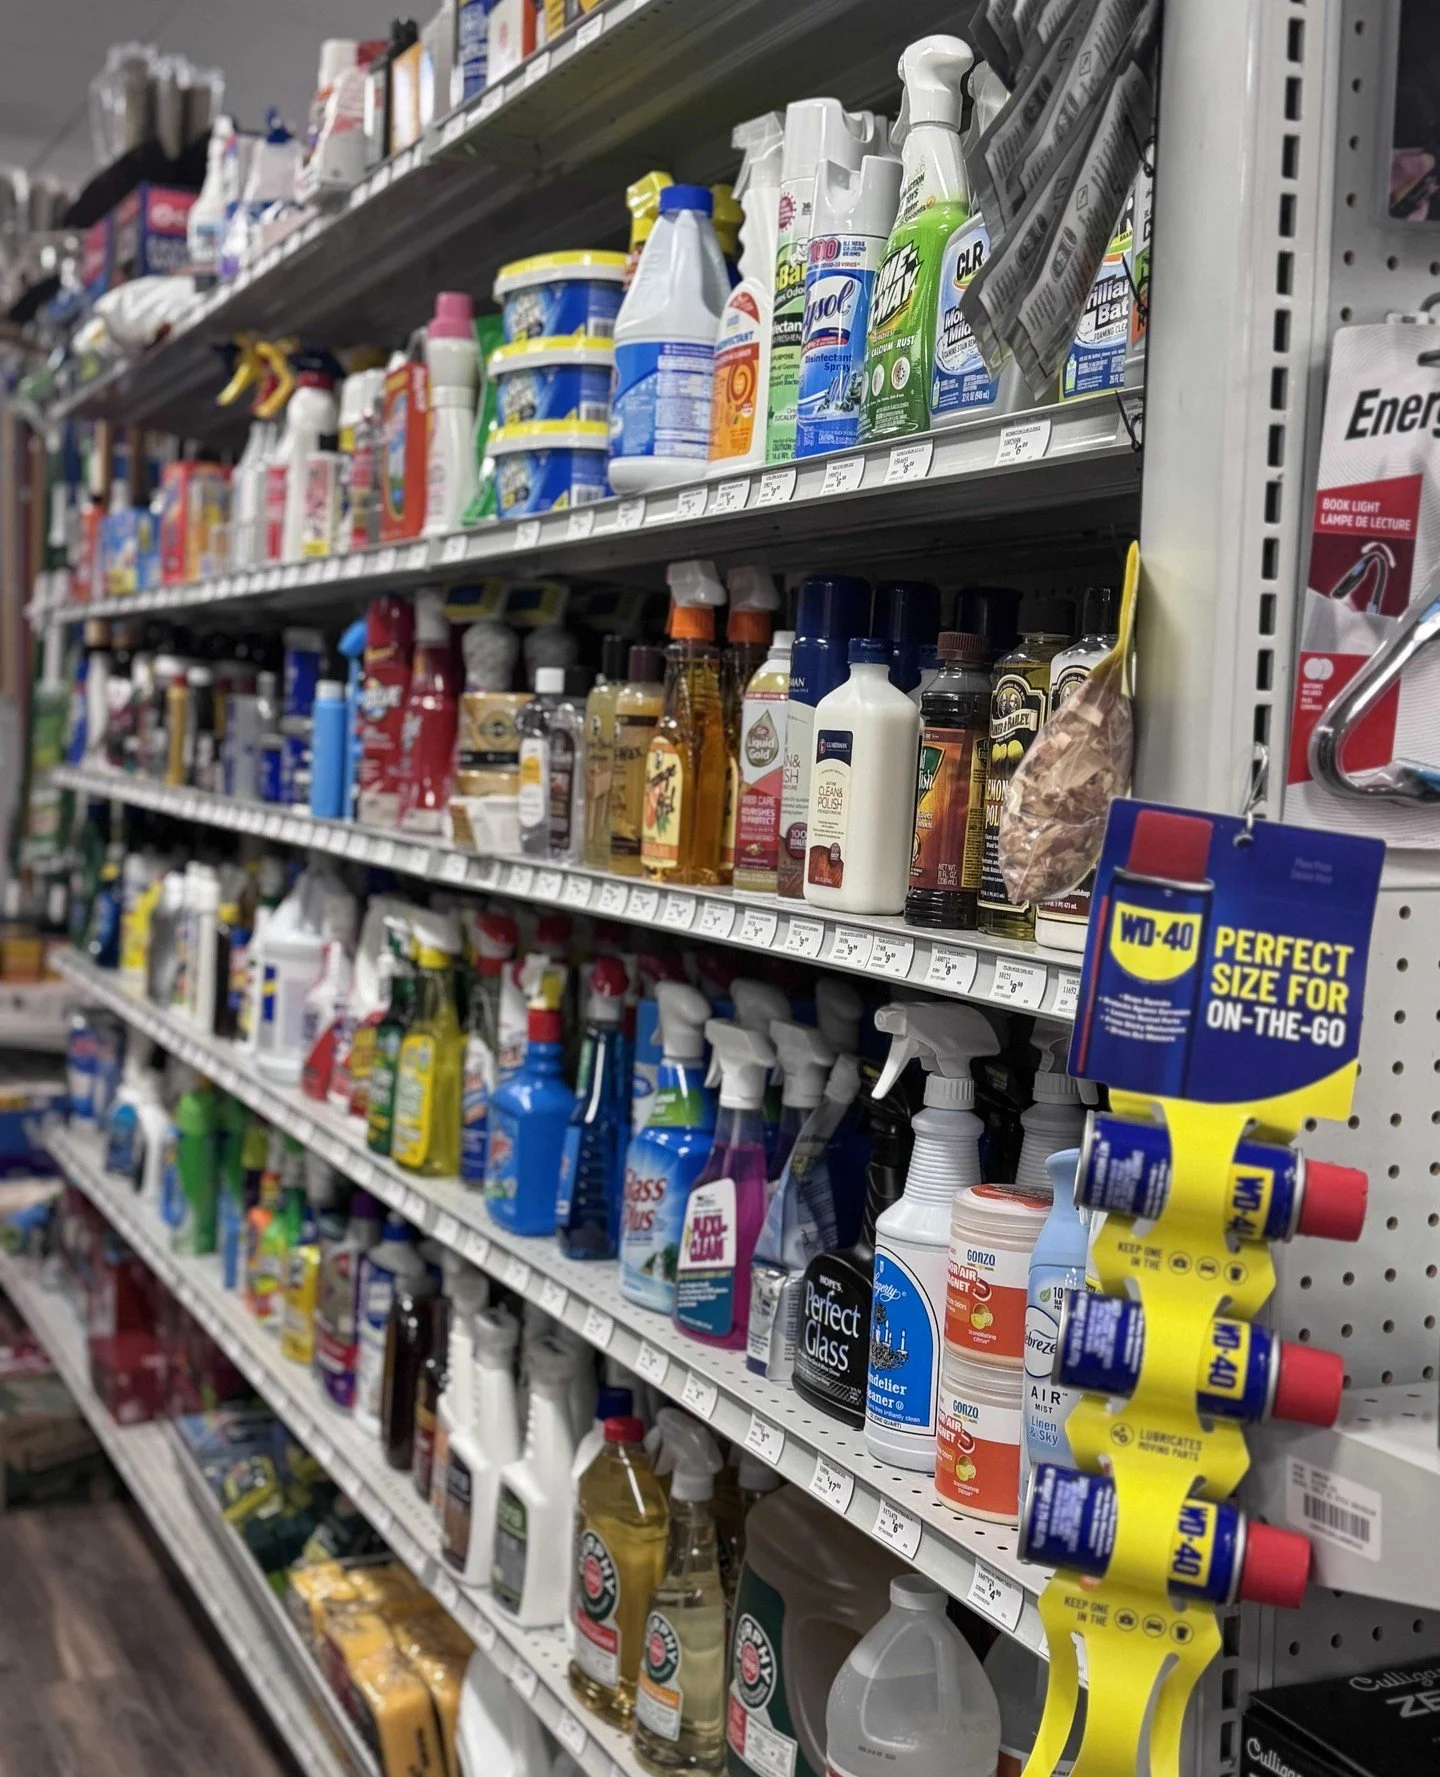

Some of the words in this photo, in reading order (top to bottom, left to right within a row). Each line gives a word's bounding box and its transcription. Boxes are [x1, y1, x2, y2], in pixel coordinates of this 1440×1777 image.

[957, 240, 984, 281] CLR
[1097, 299, 1129, 324] Bat
[872, 342, 893, 357] CALCIUM
[896, 336, 915, 348] RUST
[805, 354, 852, 364] Disinfectant
[824, 363, 851, 372] Spray
[1323, 498, 1350, 510] BOOK
[1352, 501, 1381, 513] LIGHT
[1321, 514, 1353, 527] LAMPE
[1356, 516, 1368, 528] DE
[1370, 518, 1411, 531] LECTURE
[747, 737, 775, 750] Liquid
[748, 749, 770, 760] Gold
[758, 795, 776, 806] CARE
[817, 797, 842, 810] POLISH
[790, 838, 807, 847] QUALI
[791, 830, 807, 839] 100
[938, 863, 948, 871] NET
[1121, 912, 1194, 951] WD-40
[1214, 925, 1354, 978] PERFECT
[1210, 962, 1281, 1005] SIZE
[1286, 974, 1349, 1014] FOR
[1206, 999, 1346, 1048] ON-THE-GO
[1118, 1241, 1142, 1255] KEEP
[1144, 1244, 1163, 1259] ONE
[1131, 1256, 1141, 1267] IN
[1144, 1258, 1161, 1271] THE
[960, 1266, 977, 1281] AIR
[819, 1275, 843, 1292] HOPE'S
[805, 1280, 861, 1339] Perfect
[805, 1319, 849, 1372] Glass
[1035, 1403, 1053, 1414] MIST
[905, 1413, 921, 1423] clean
[946, 1417, 963, 1433] AIR
[1031, 1416, 1057, 1432] Linen
[1030, 1428, 1036, 1439] &
[1039, 1430, 1059, 1447] Sky
[1139, 1428, 1202, 1451] LUBRICATES
[1138, 1442, 1169, 1456] MOVING
[1172, 1446, 1199, 1462] PARTS
[1172, 1503, 1209, 1578] WD-40
[1064, 1596, 1088, 1609] KEEP
[1090, 1600, 1110, 1614] ONE
[1077, 1611, 1088, 1622] IN
[1090, 1614, 1108, 1627] THE
[1348, 1668, 1440, 1692] Culliga
[1385, 1689, 1440, 1718] ZE
